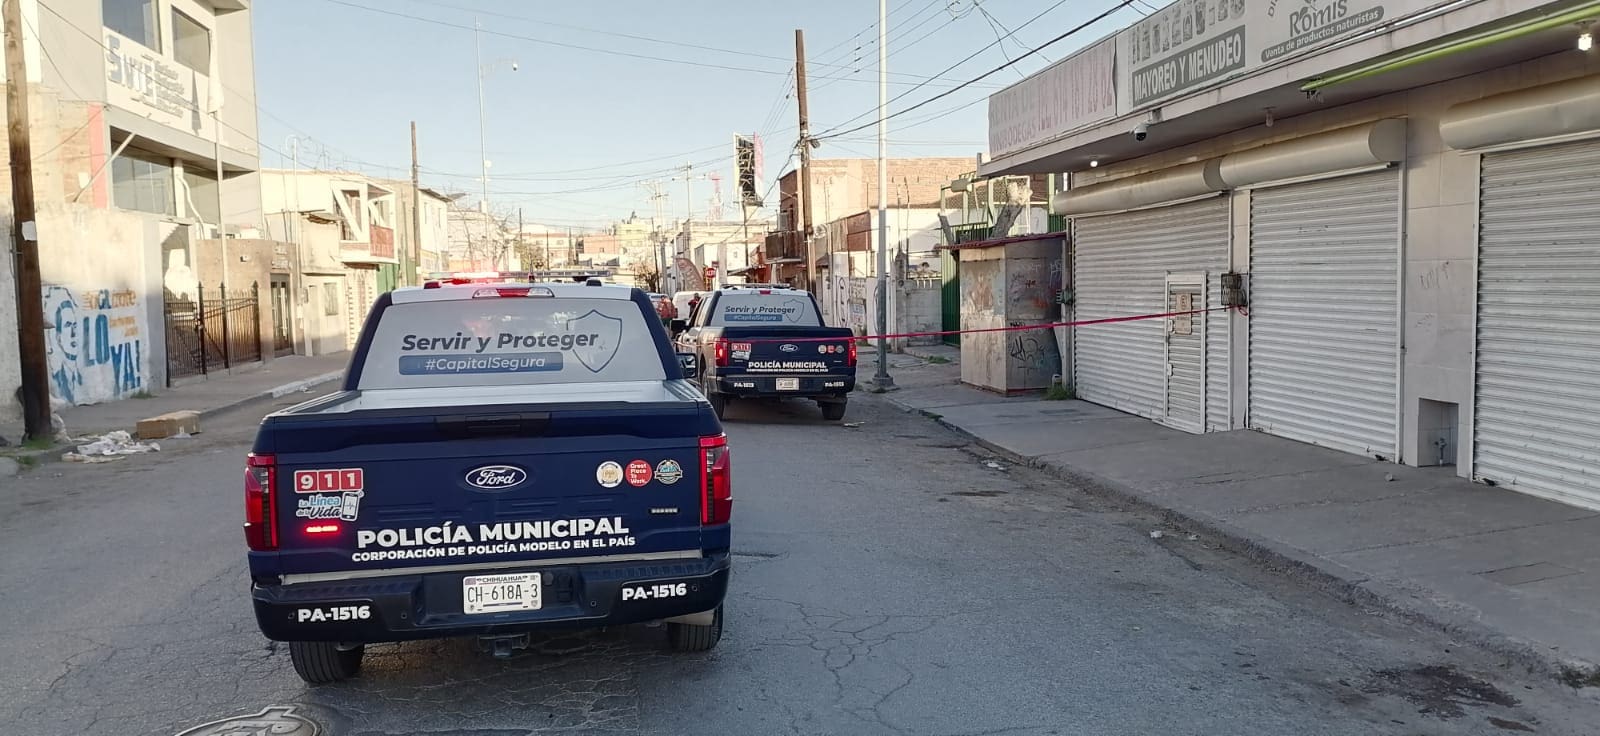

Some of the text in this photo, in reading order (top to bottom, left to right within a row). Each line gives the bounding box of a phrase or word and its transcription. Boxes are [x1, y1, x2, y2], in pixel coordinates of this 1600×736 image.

[1289, 0, 1347, 37] Romis
[1265, 9, 1379, 59] Venta de productos naturistas
[1134, 33, 1242, 101] MAYOREO Y MENUDEO
[725, 305, 750, 313] Servir
[759, 306, 796, 315] Proteger
[402, 331, 599, 353] Servir y Proteger
[424, 357, 546, 373] #CapitalSegura
[748, 361, 827, 369] POLICÍA MUNICIPAL
[301, 472, 355, 490] 911
[476, 468, 515, 486] Ford
[310, 494, 340, 506] Línea
[310, 506, 342, 519] Vida
[357, 517, 630, 549] POLICÍA MUNICIPAL
[351, 535, 636, 563] CORPORACIÓN DE POLICÍA MODELO EN EL PAÍS
[482, 575, 522, 583] CHIHUAHUA
[467, 583, 538, 603] CH-618A-3
[297, 583, 687, 623] PA-1516 PA-1516
